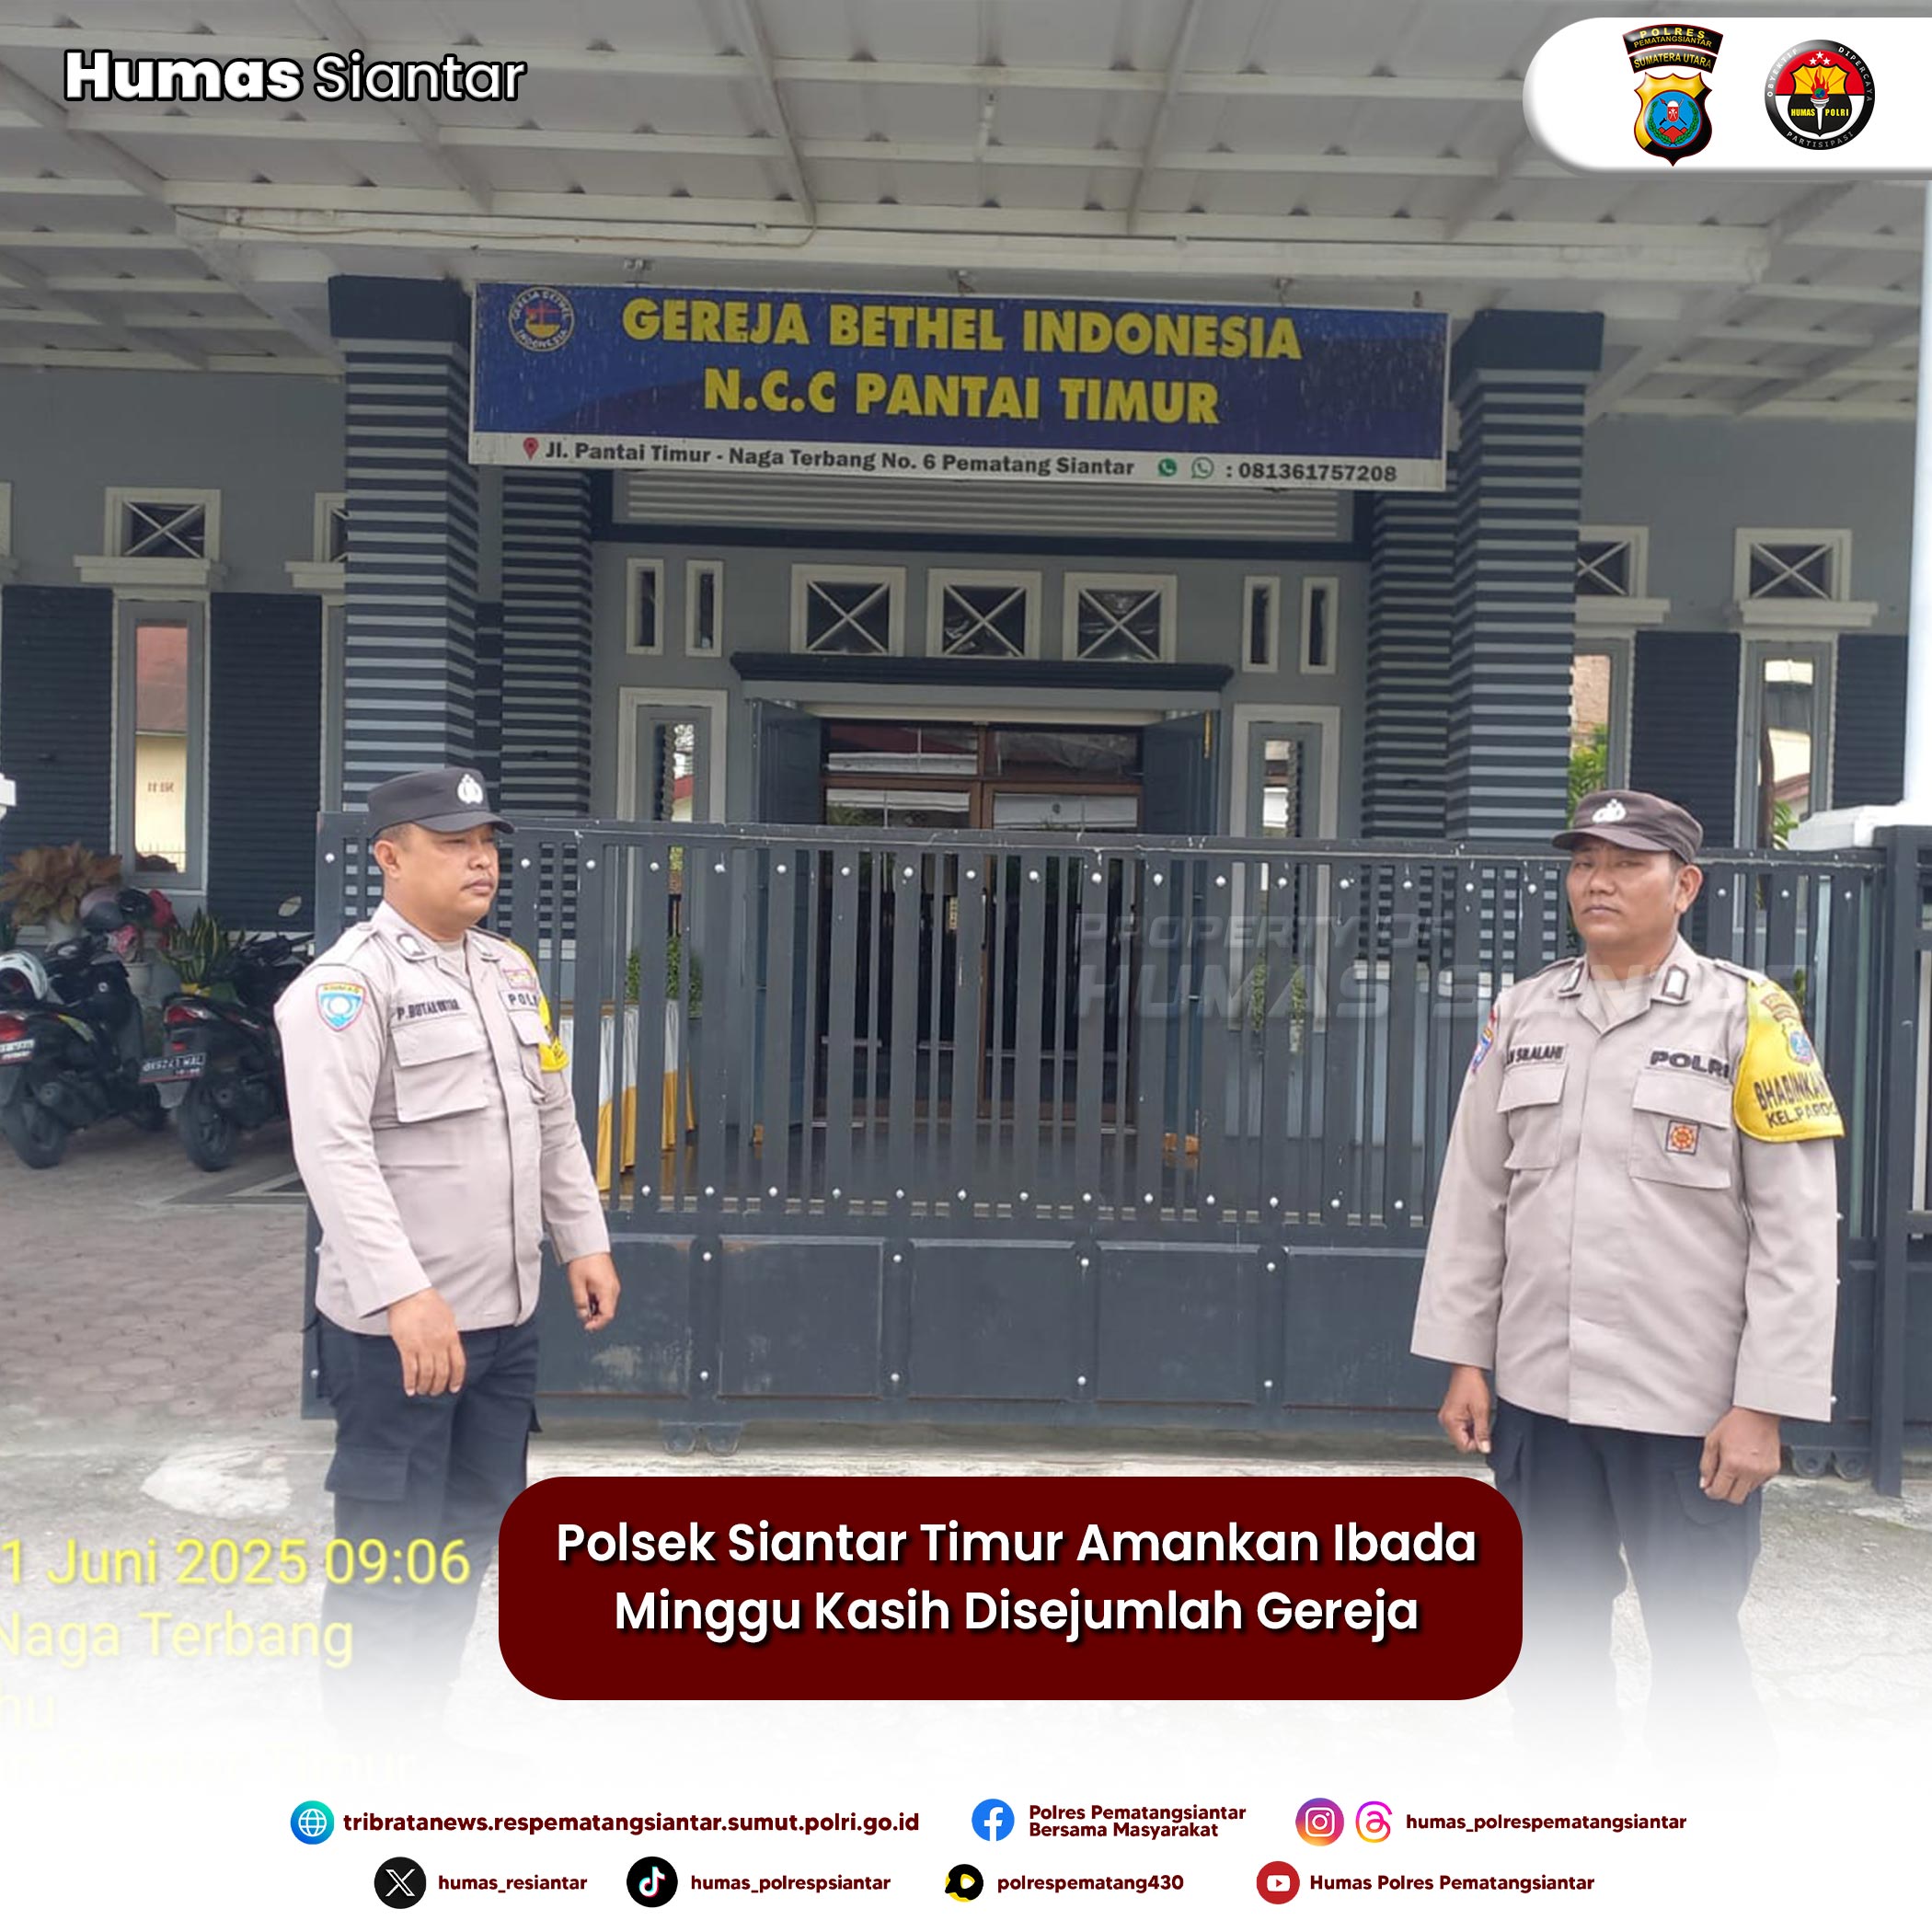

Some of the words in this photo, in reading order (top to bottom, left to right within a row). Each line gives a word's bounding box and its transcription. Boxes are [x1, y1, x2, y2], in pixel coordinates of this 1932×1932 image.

[623, 297, 810, 345] GEREJA
[830, 305, 1004, 351] BETHEL
[1023, 309, 1303, 360] INDONESIA
[705, 367, 836, 413] N.C.C
[857, 372, 1040, 420] PANTAI
[1059, 377, 1220, 424] TIMUR
[546, 442, 569, 459] Jl.
[575, 443, 645, 461] Pantai
[651, 444, 711, 463] Timur
[730, 447, 783, 468] Naga
[789, 448, 876, 472] Terbang
[881, 452, 916, 469] No.
[923, 454, 937, 470] 6
[942, 454, 1051, 477] Pematang
[1056, 456, 1135, 476] Siantar
[1238, 462, 1397, 482] 081361757208
